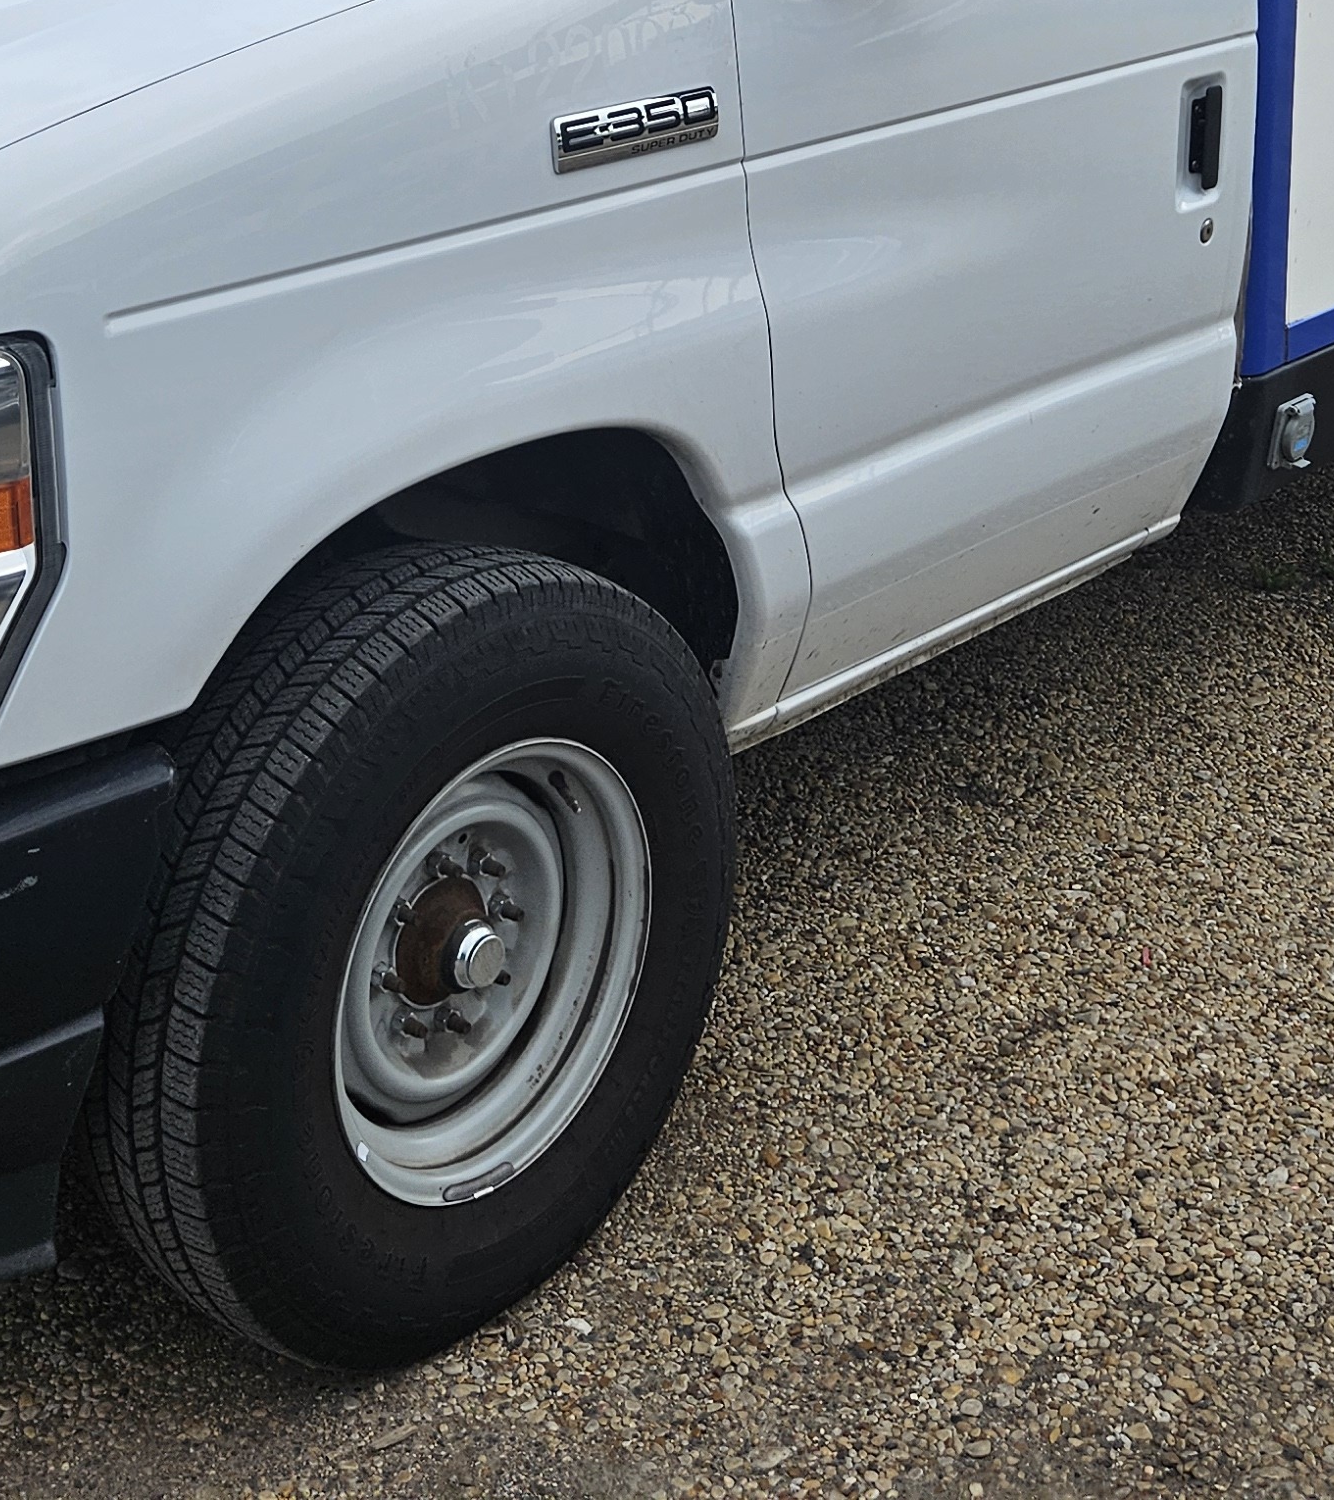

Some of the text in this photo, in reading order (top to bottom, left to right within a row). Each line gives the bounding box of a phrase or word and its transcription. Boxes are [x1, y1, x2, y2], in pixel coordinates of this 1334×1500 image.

[560, 89, 717, 153] E-350
[631, 126, 714, 155] SUPER DUTY
